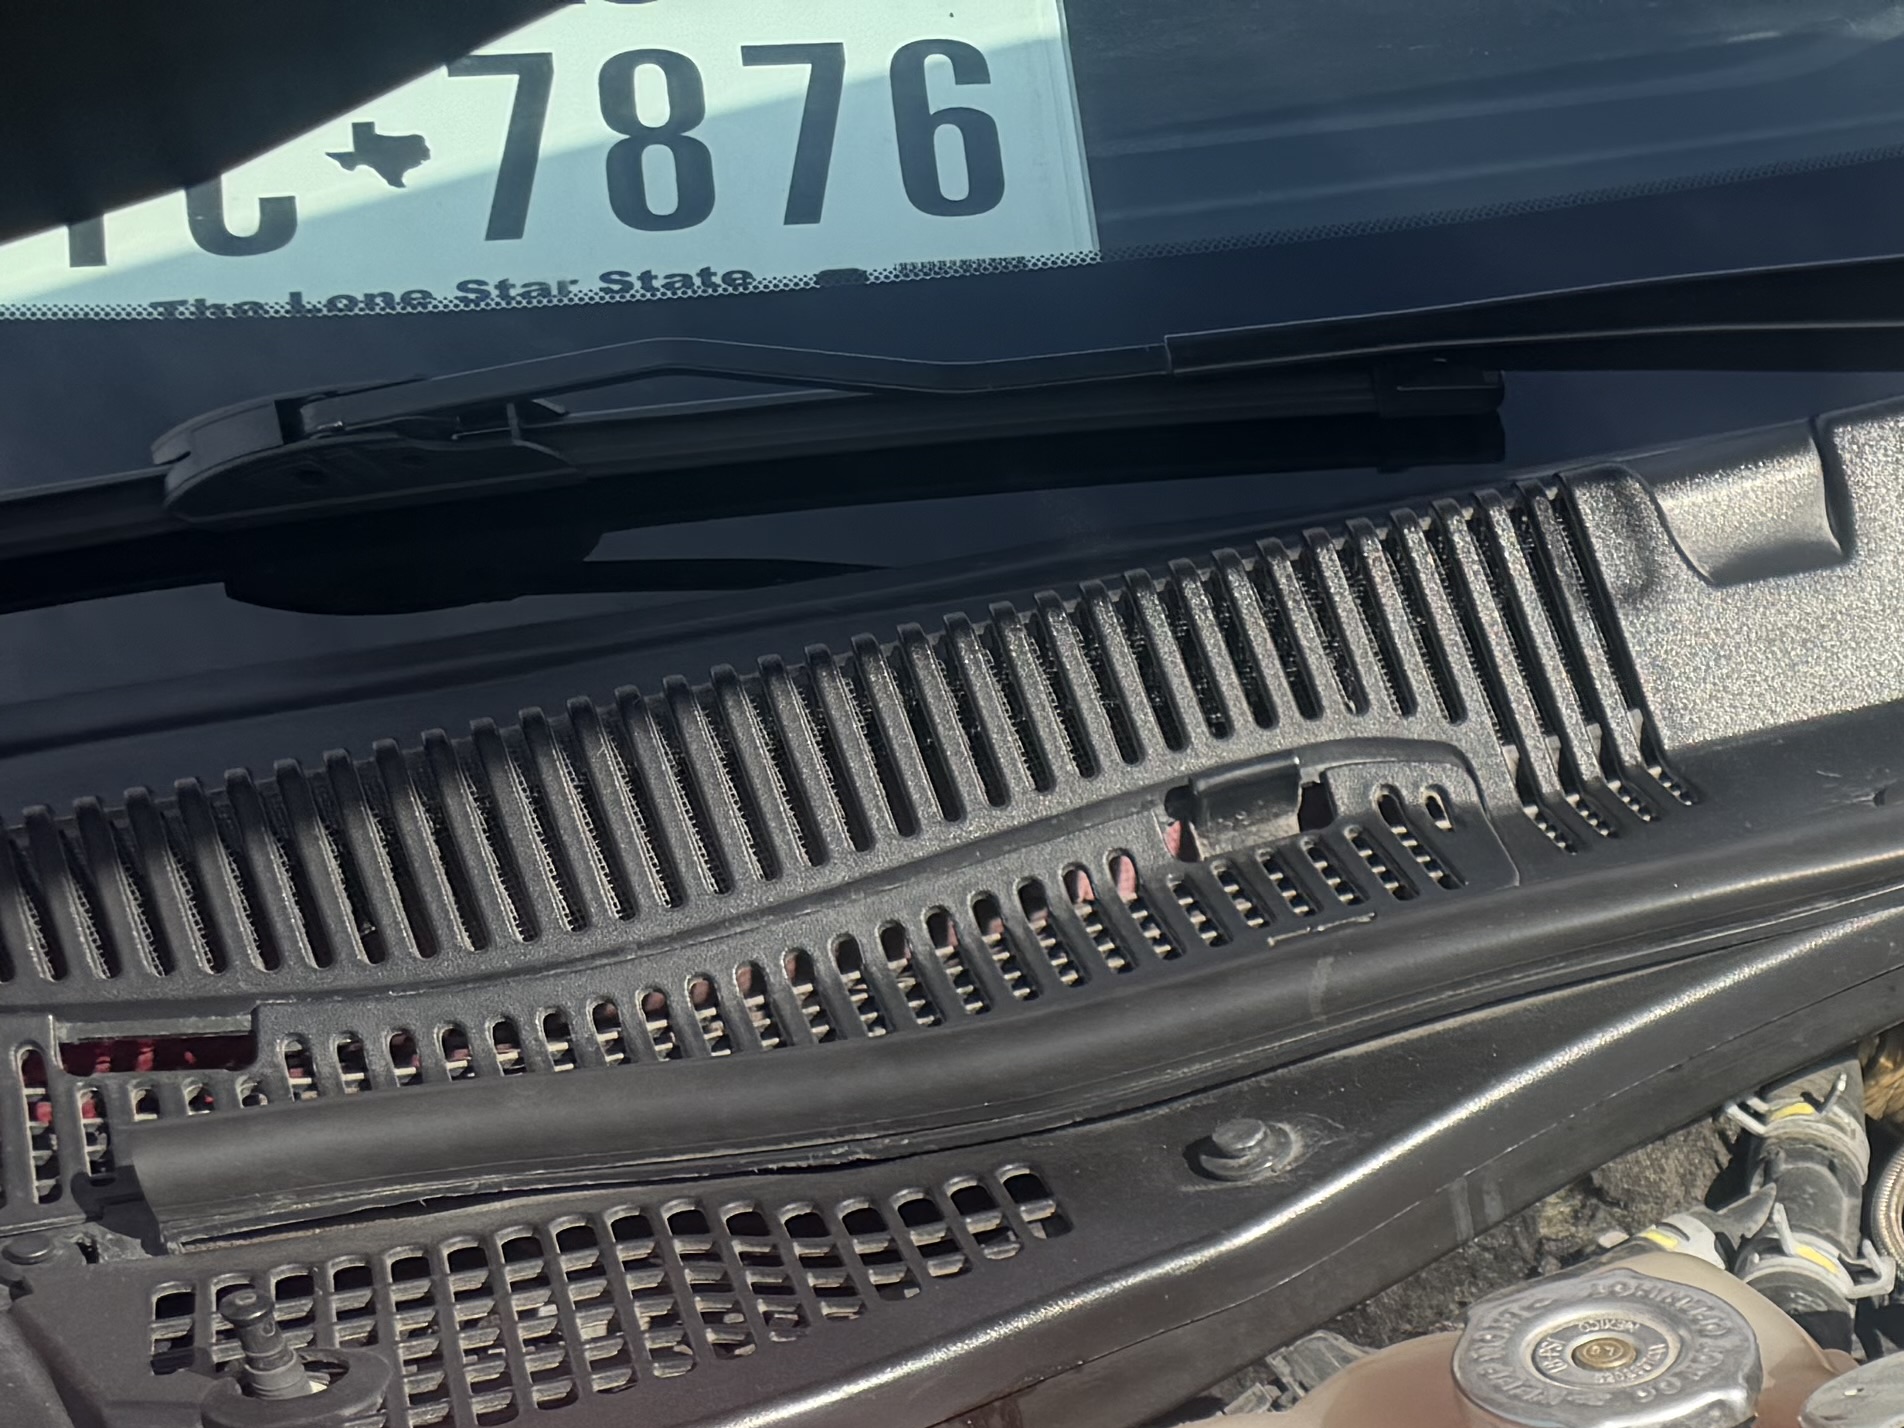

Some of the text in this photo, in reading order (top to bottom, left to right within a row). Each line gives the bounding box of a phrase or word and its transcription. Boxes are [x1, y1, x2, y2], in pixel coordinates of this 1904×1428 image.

[446, 38, 1007, 243] 7876
[455, 275, 579, 303] Star
[597, 264, 755, 297] State
